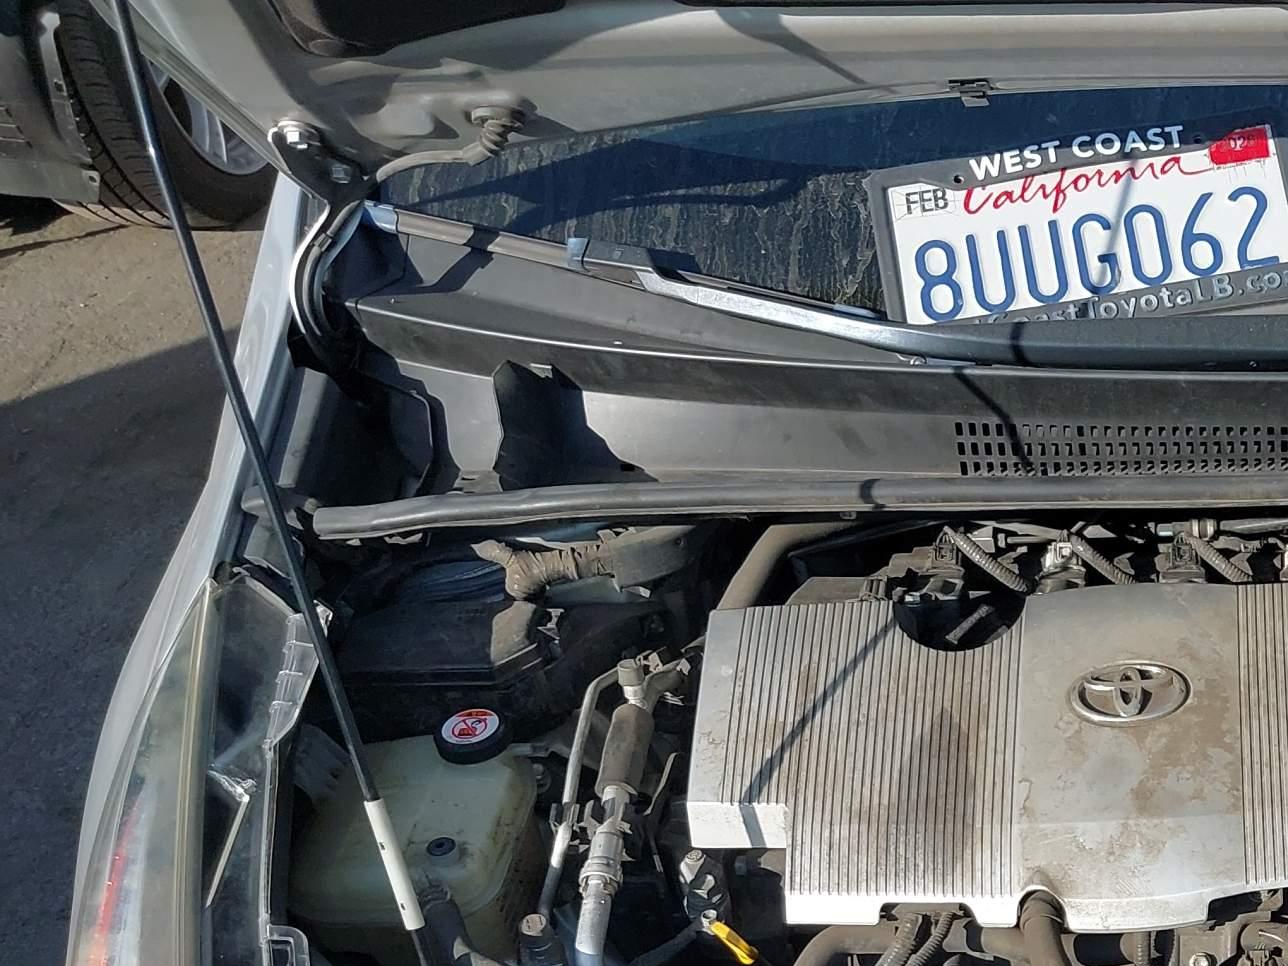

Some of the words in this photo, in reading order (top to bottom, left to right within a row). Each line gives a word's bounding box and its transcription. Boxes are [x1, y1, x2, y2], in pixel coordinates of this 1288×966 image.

[968, 141, 1060, 182] WEST
[1072, 125, 1184, 157] COAST
[905, 187, 949, 216] FEB
[914, 185, 1280, 323] 8UUG062
